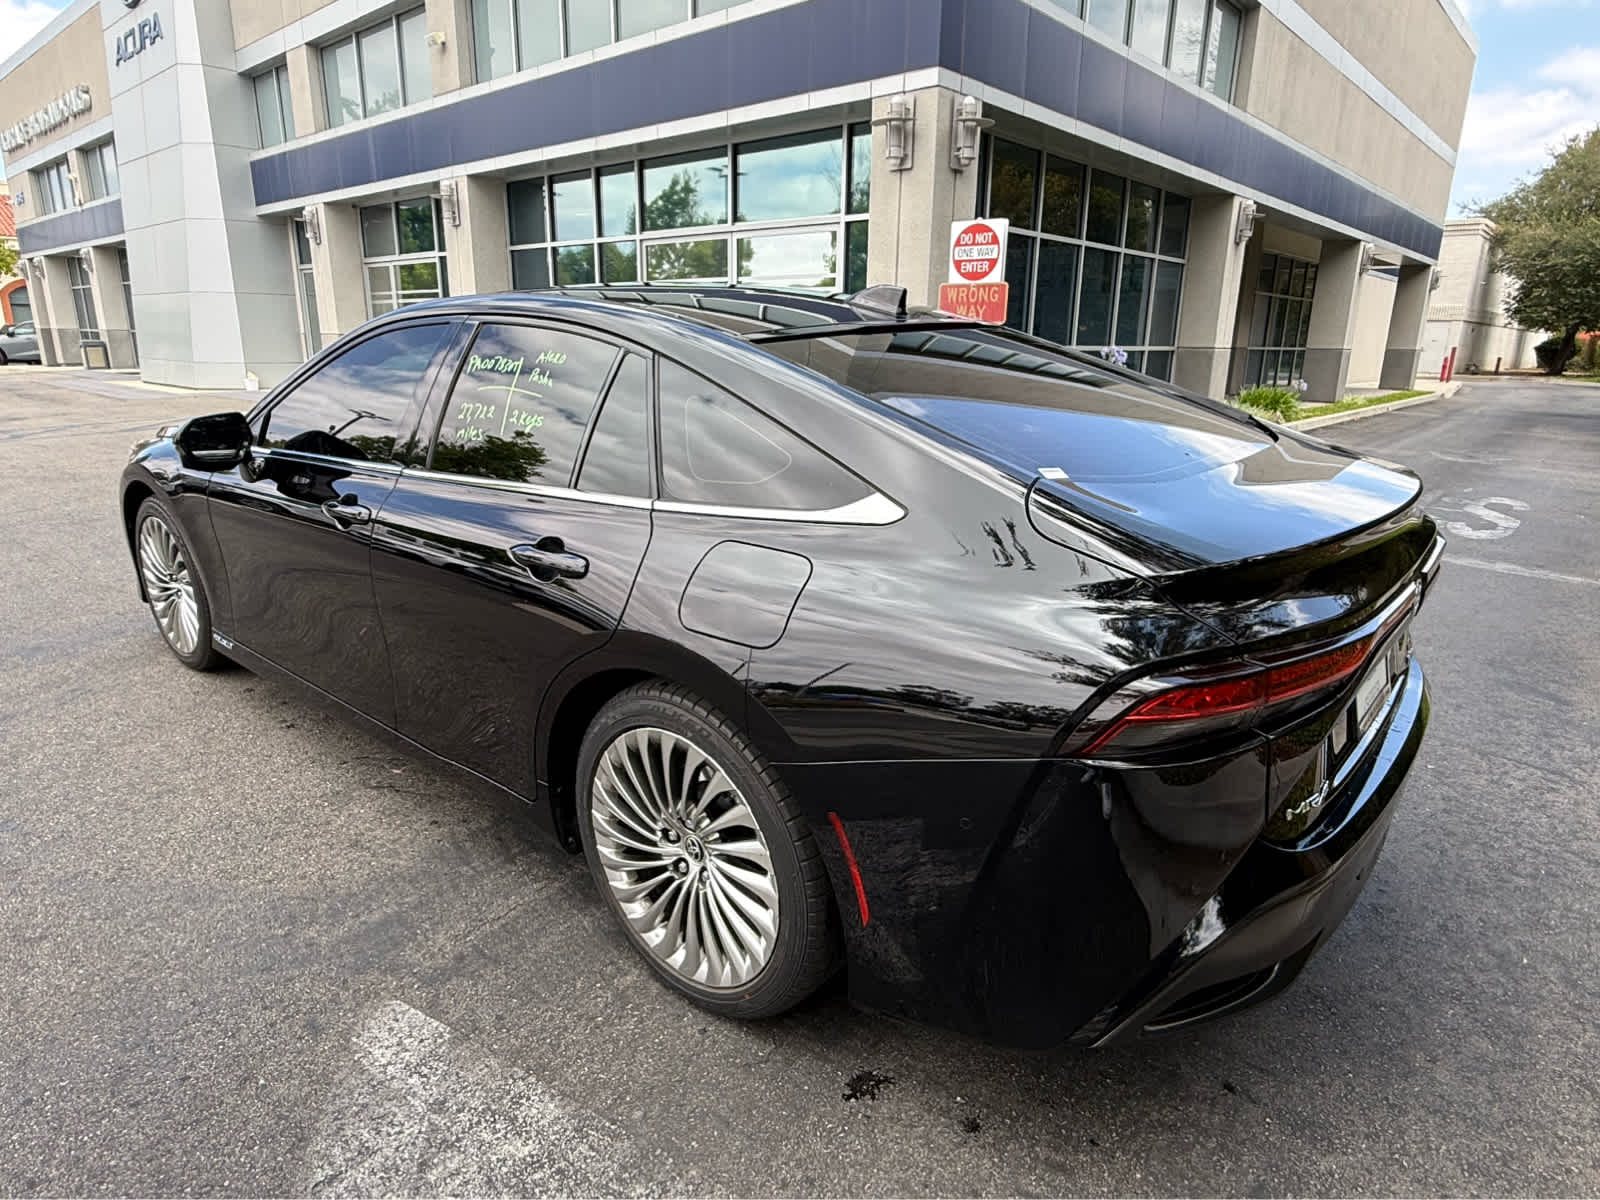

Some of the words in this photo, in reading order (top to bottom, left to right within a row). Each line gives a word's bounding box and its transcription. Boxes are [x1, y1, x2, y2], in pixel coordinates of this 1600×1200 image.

[115, 12, 163, 67] ACURA
[960, 233, 973, 245] DO
[975, 232, 993, 244] NOT
[957, 248, 975, 258] ONE
[976, 246, 996, 257] WAY
[961, 261, 990, 273] ENTER
[946, 286, 1000, 304] WRONG
[956, 304, 987, 320] WAY
